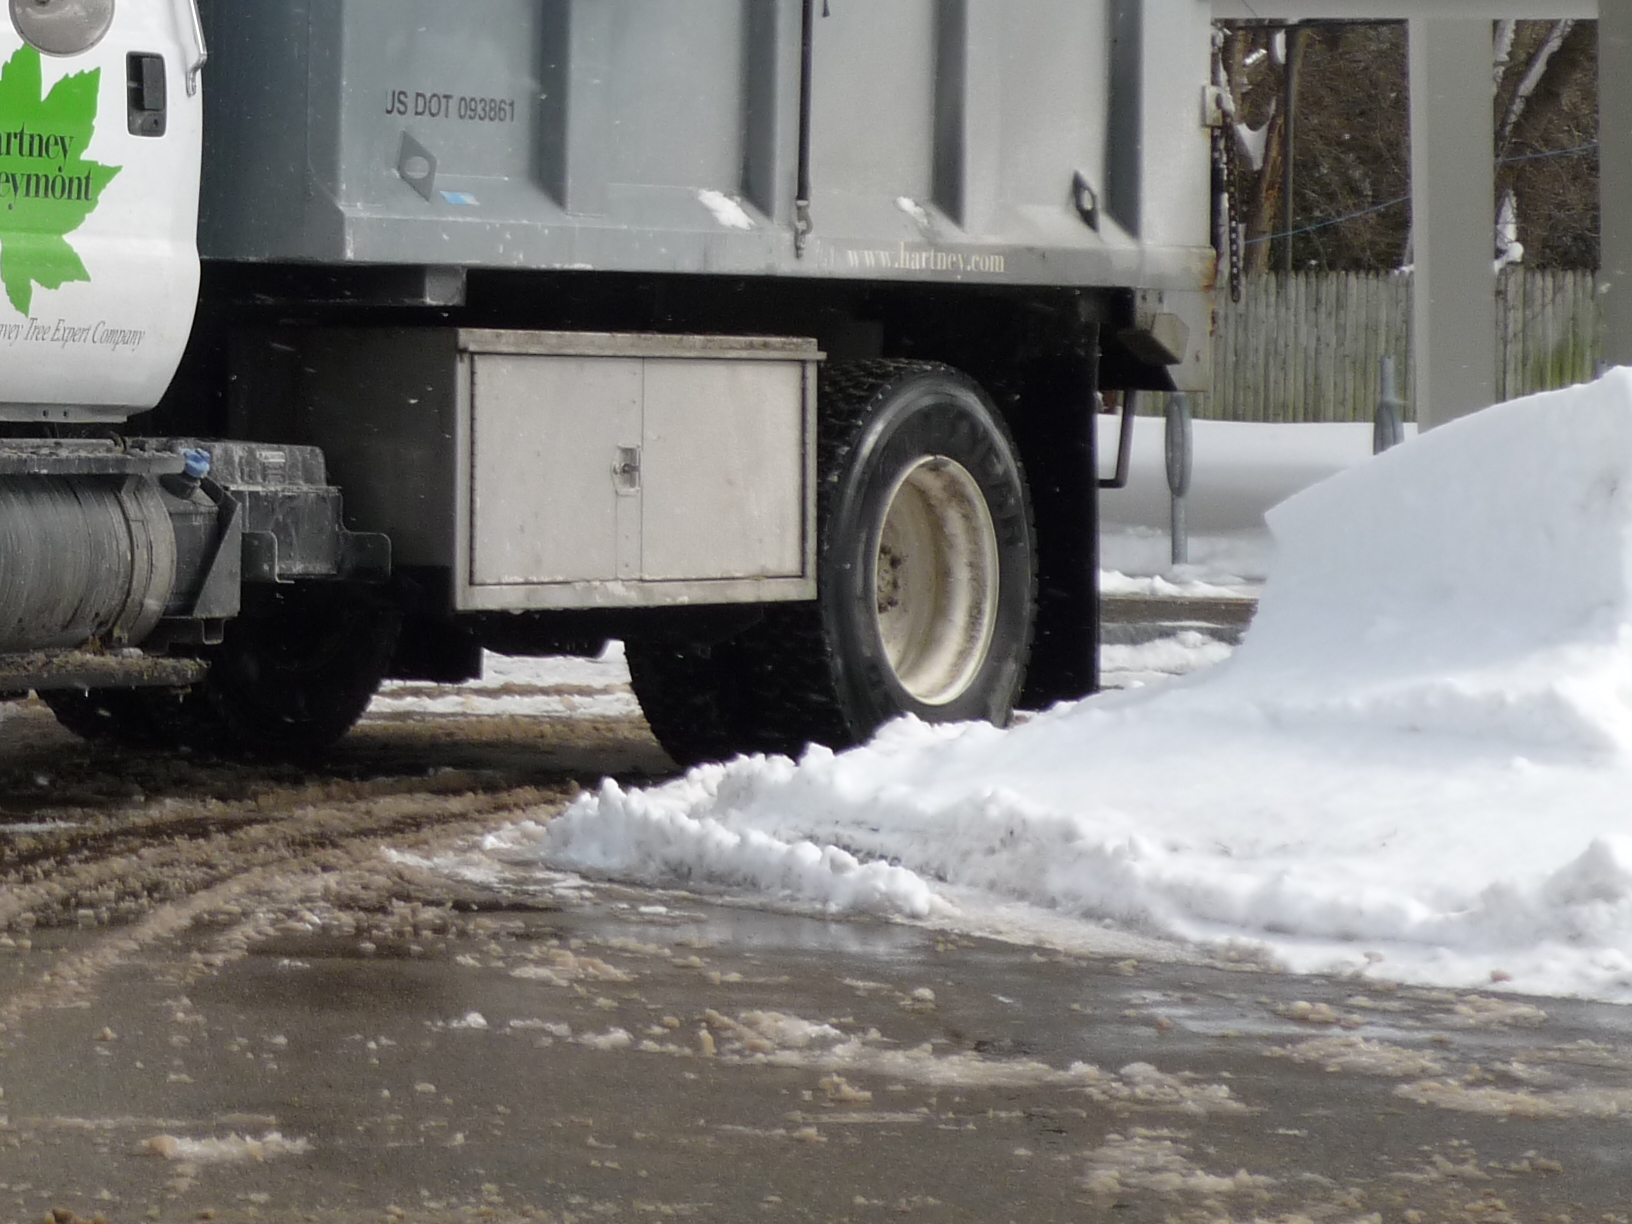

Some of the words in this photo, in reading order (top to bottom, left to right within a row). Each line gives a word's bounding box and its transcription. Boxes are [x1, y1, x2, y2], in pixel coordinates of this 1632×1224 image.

[415, 92, 453, 118] DOT
[458, 96, 515, 122] 093861
[847, 241, 1006, 280] www.hartney.com
[24, 317, 51, 342] Tree
[50, 319, 91, 349] Expert
[92, 320, 145, 352] Company
